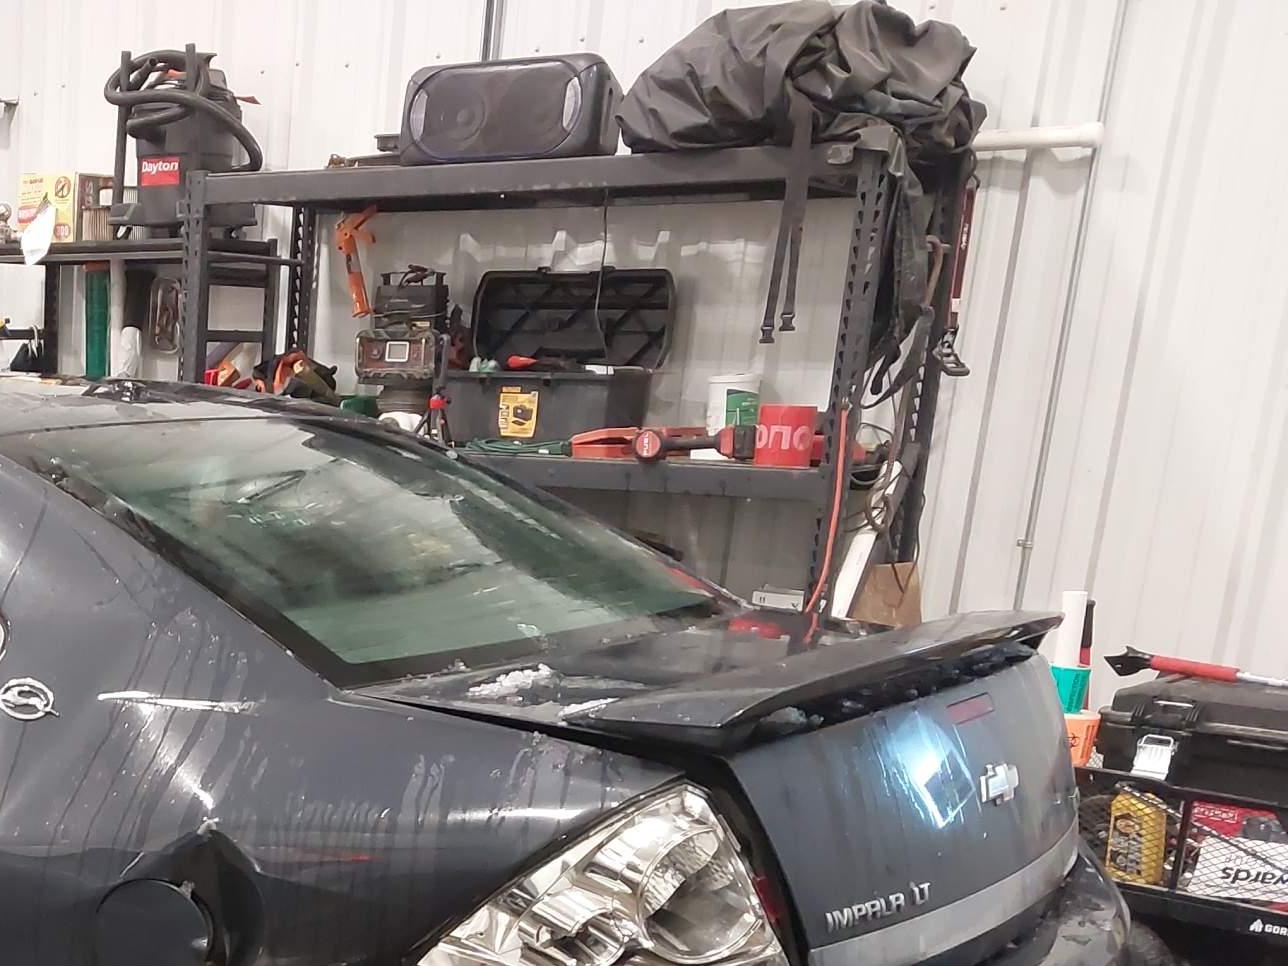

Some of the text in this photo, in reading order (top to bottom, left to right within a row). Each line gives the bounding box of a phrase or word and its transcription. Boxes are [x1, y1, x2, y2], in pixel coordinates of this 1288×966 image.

[141, 160, 179, 175] Dayton
[825, 882, 931, 932] IMPALA LT
[1264, 923, 1288, 937] GOR
